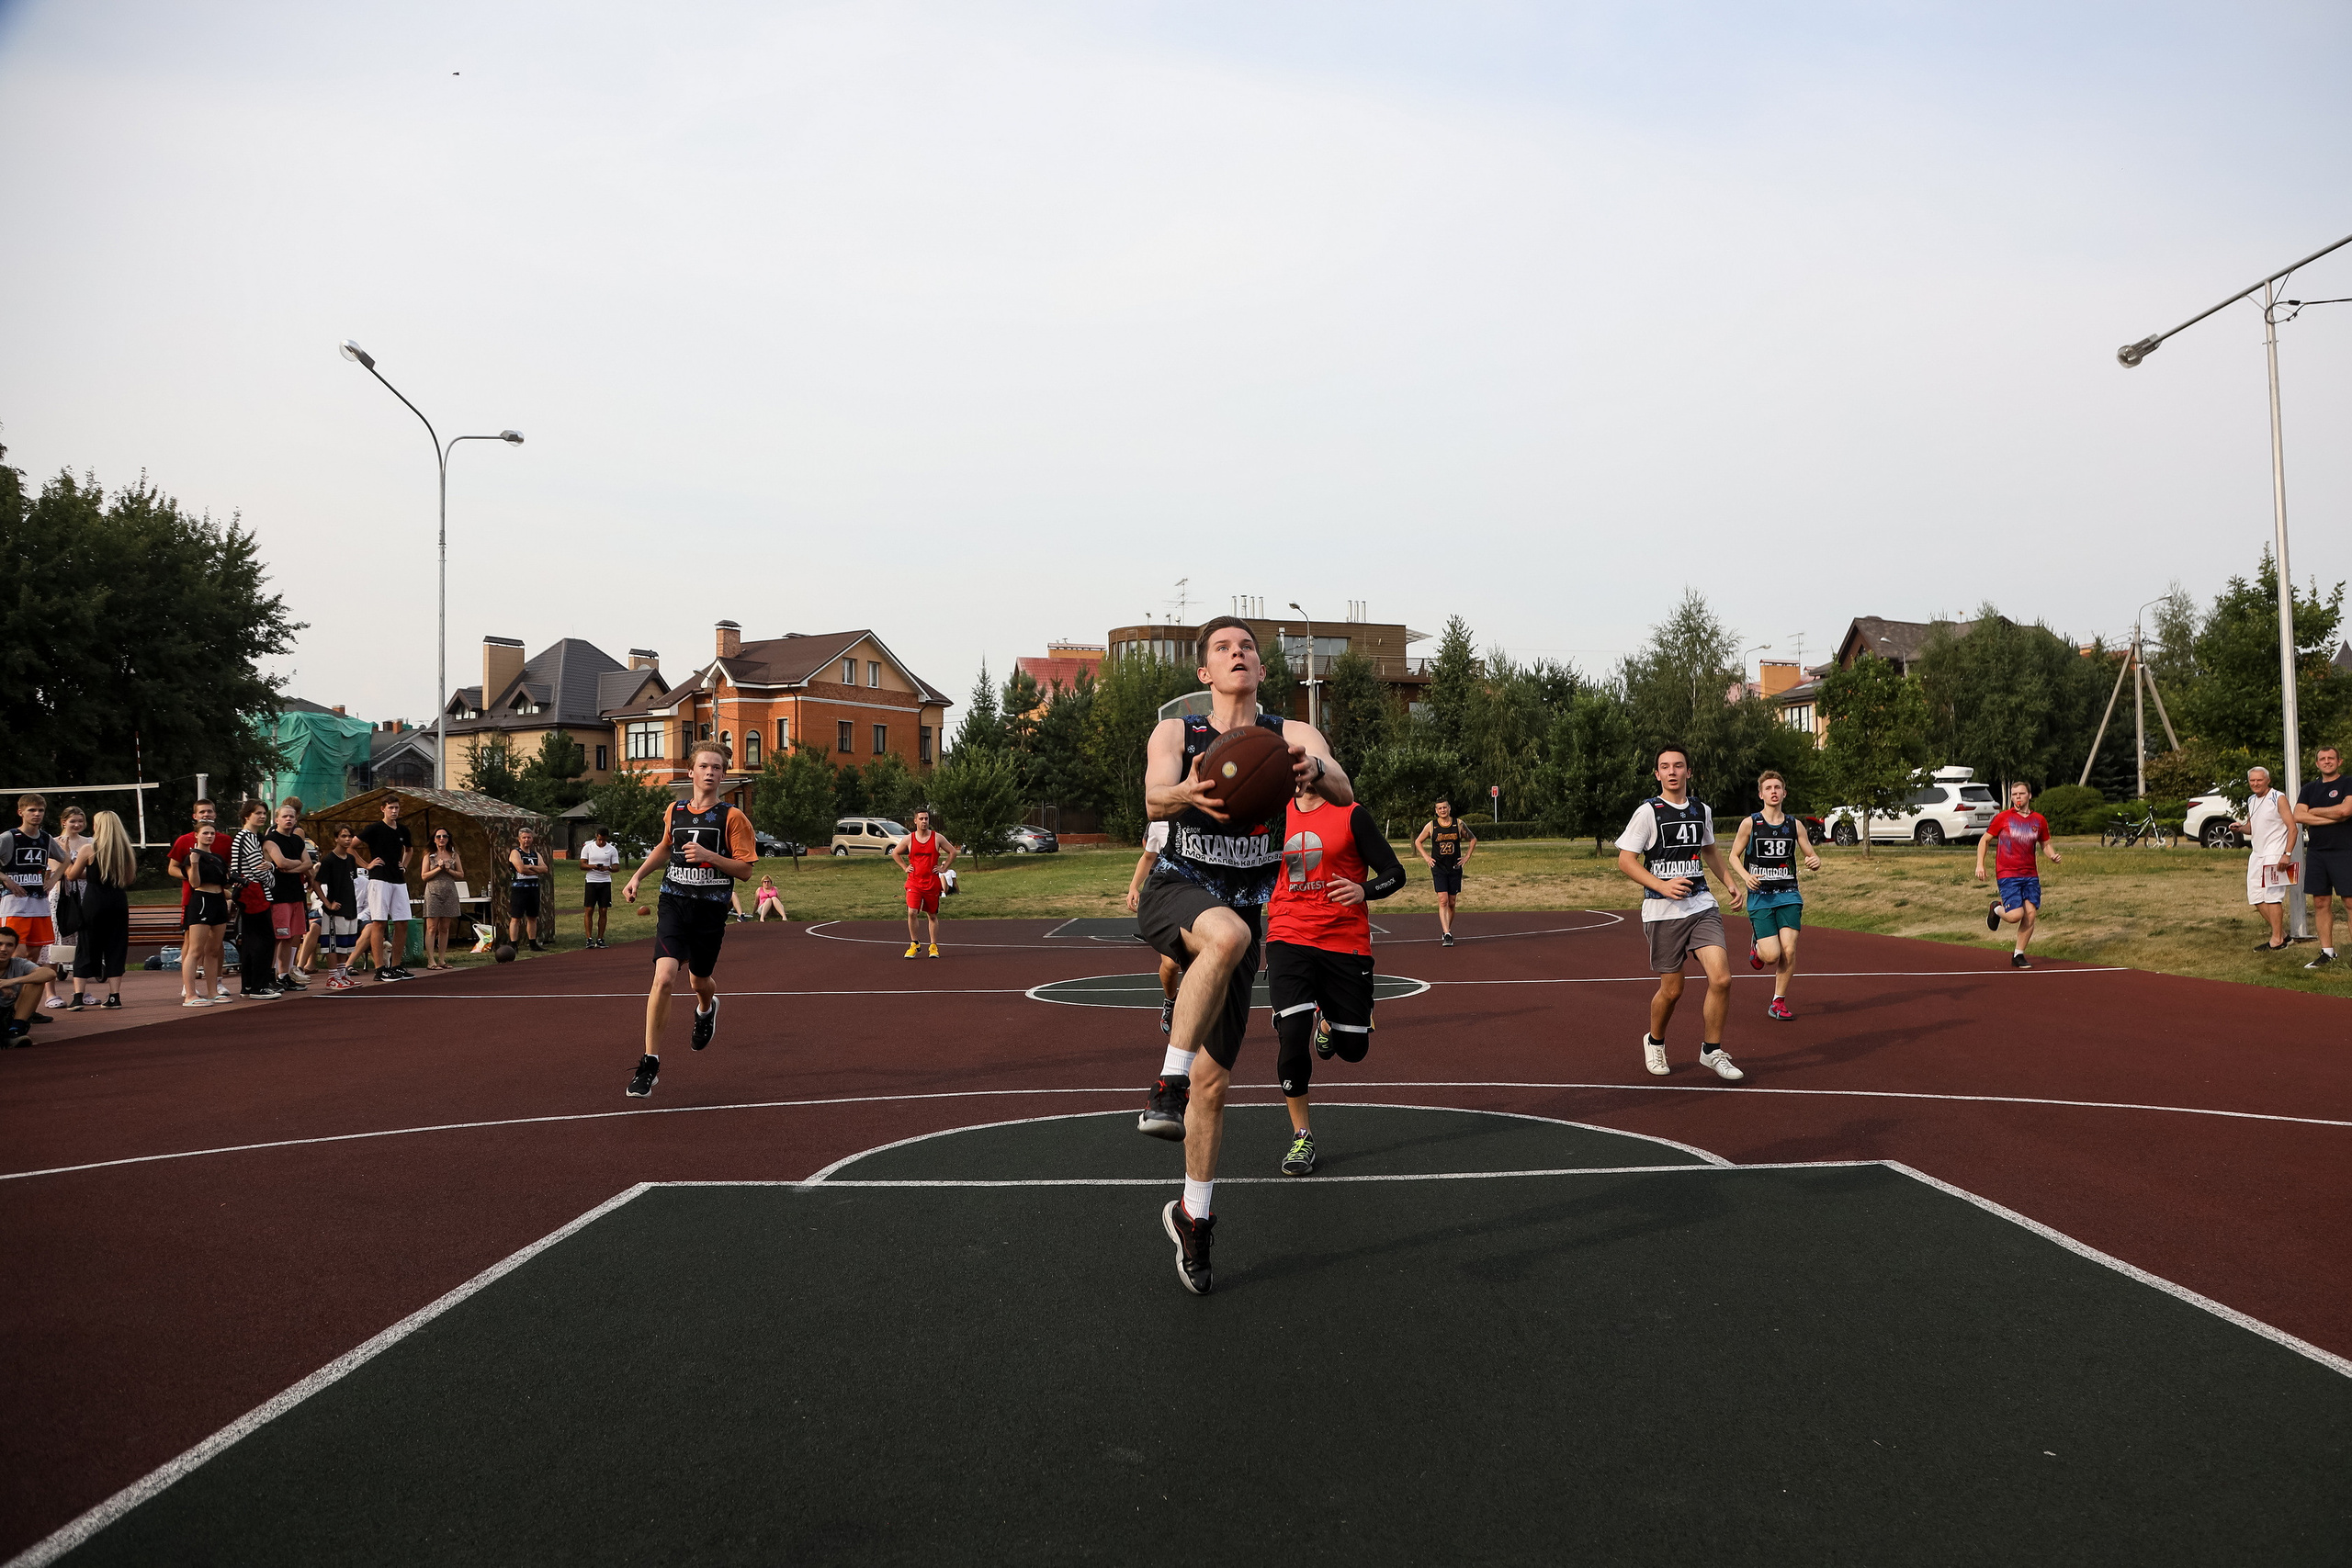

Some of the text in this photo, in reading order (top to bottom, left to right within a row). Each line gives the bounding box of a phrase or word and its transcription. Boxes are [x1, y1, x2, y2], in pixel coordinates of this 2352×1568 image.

[687, 829, 699, 843] 7
[1676, 823, 1697, 843] 41
[1764, 840, 1786, 855] 38
[24, 849, 42, 863] 44
[1288, 880, 1326, 892] PROTEST
